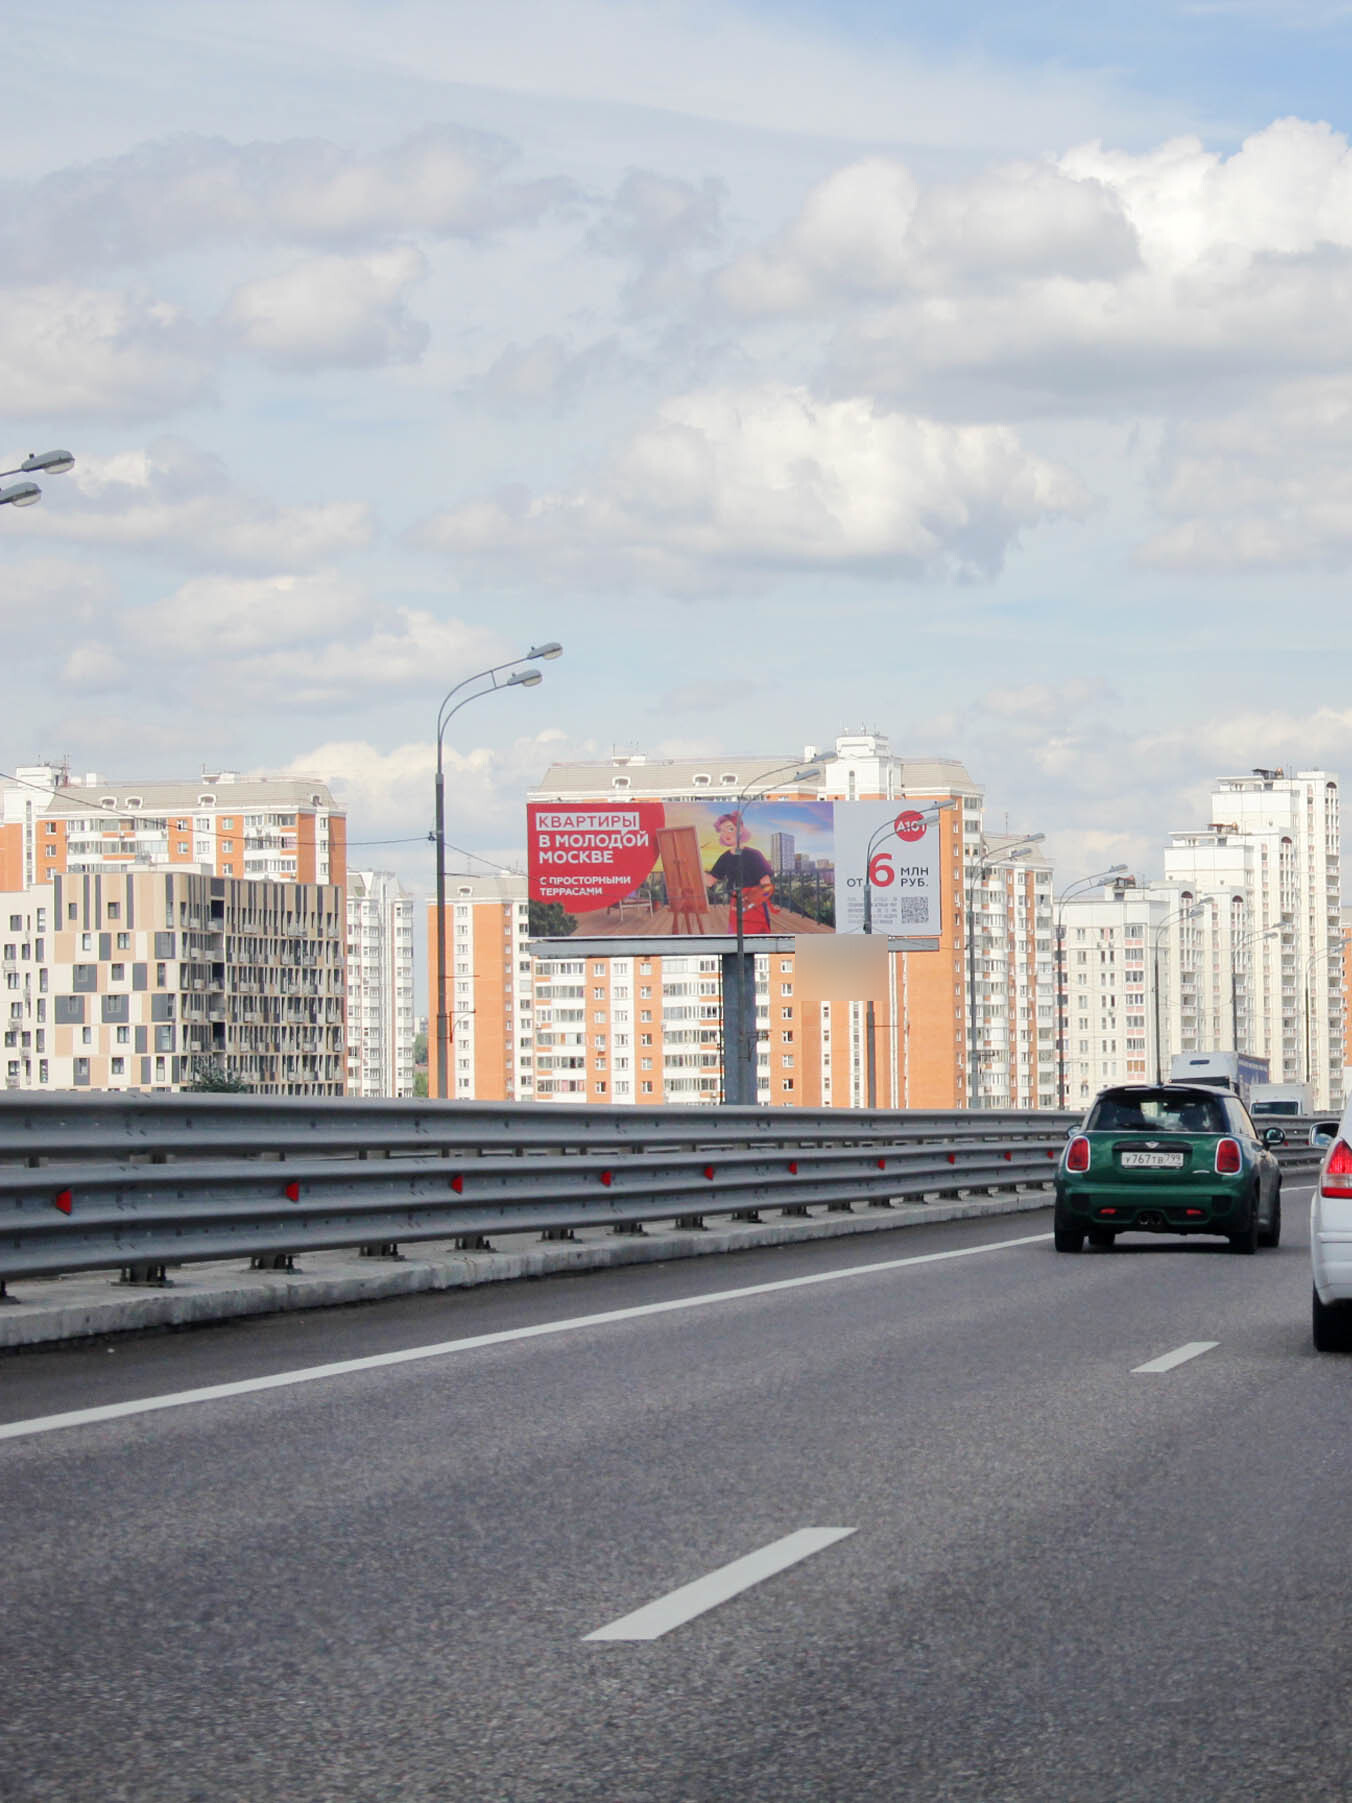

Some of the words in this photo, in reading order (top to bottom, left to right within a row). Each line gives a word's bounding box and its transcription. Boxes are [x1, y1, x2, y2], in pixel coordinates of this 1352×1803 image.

[538, 815, 637, 829] КВАРТИРЫ
[538, 834, 551, 848] В
[555, 830, 649, 849] МОЛОДОЙ
[538, 850, 615, 864] МОСКВЕ
[846, 878, 864, 888] ОТ
[869, 852, 895, 888] 6
[900, 866, 929, 876] МЛН
[539, 876, 547, 886] С
[549, 875, 632, 886] ПРОСТОРНЫМИ
[900, 878, 929, 888] РУБ.
[538, 887, 603, 897] ТЕРРАСАМИ
